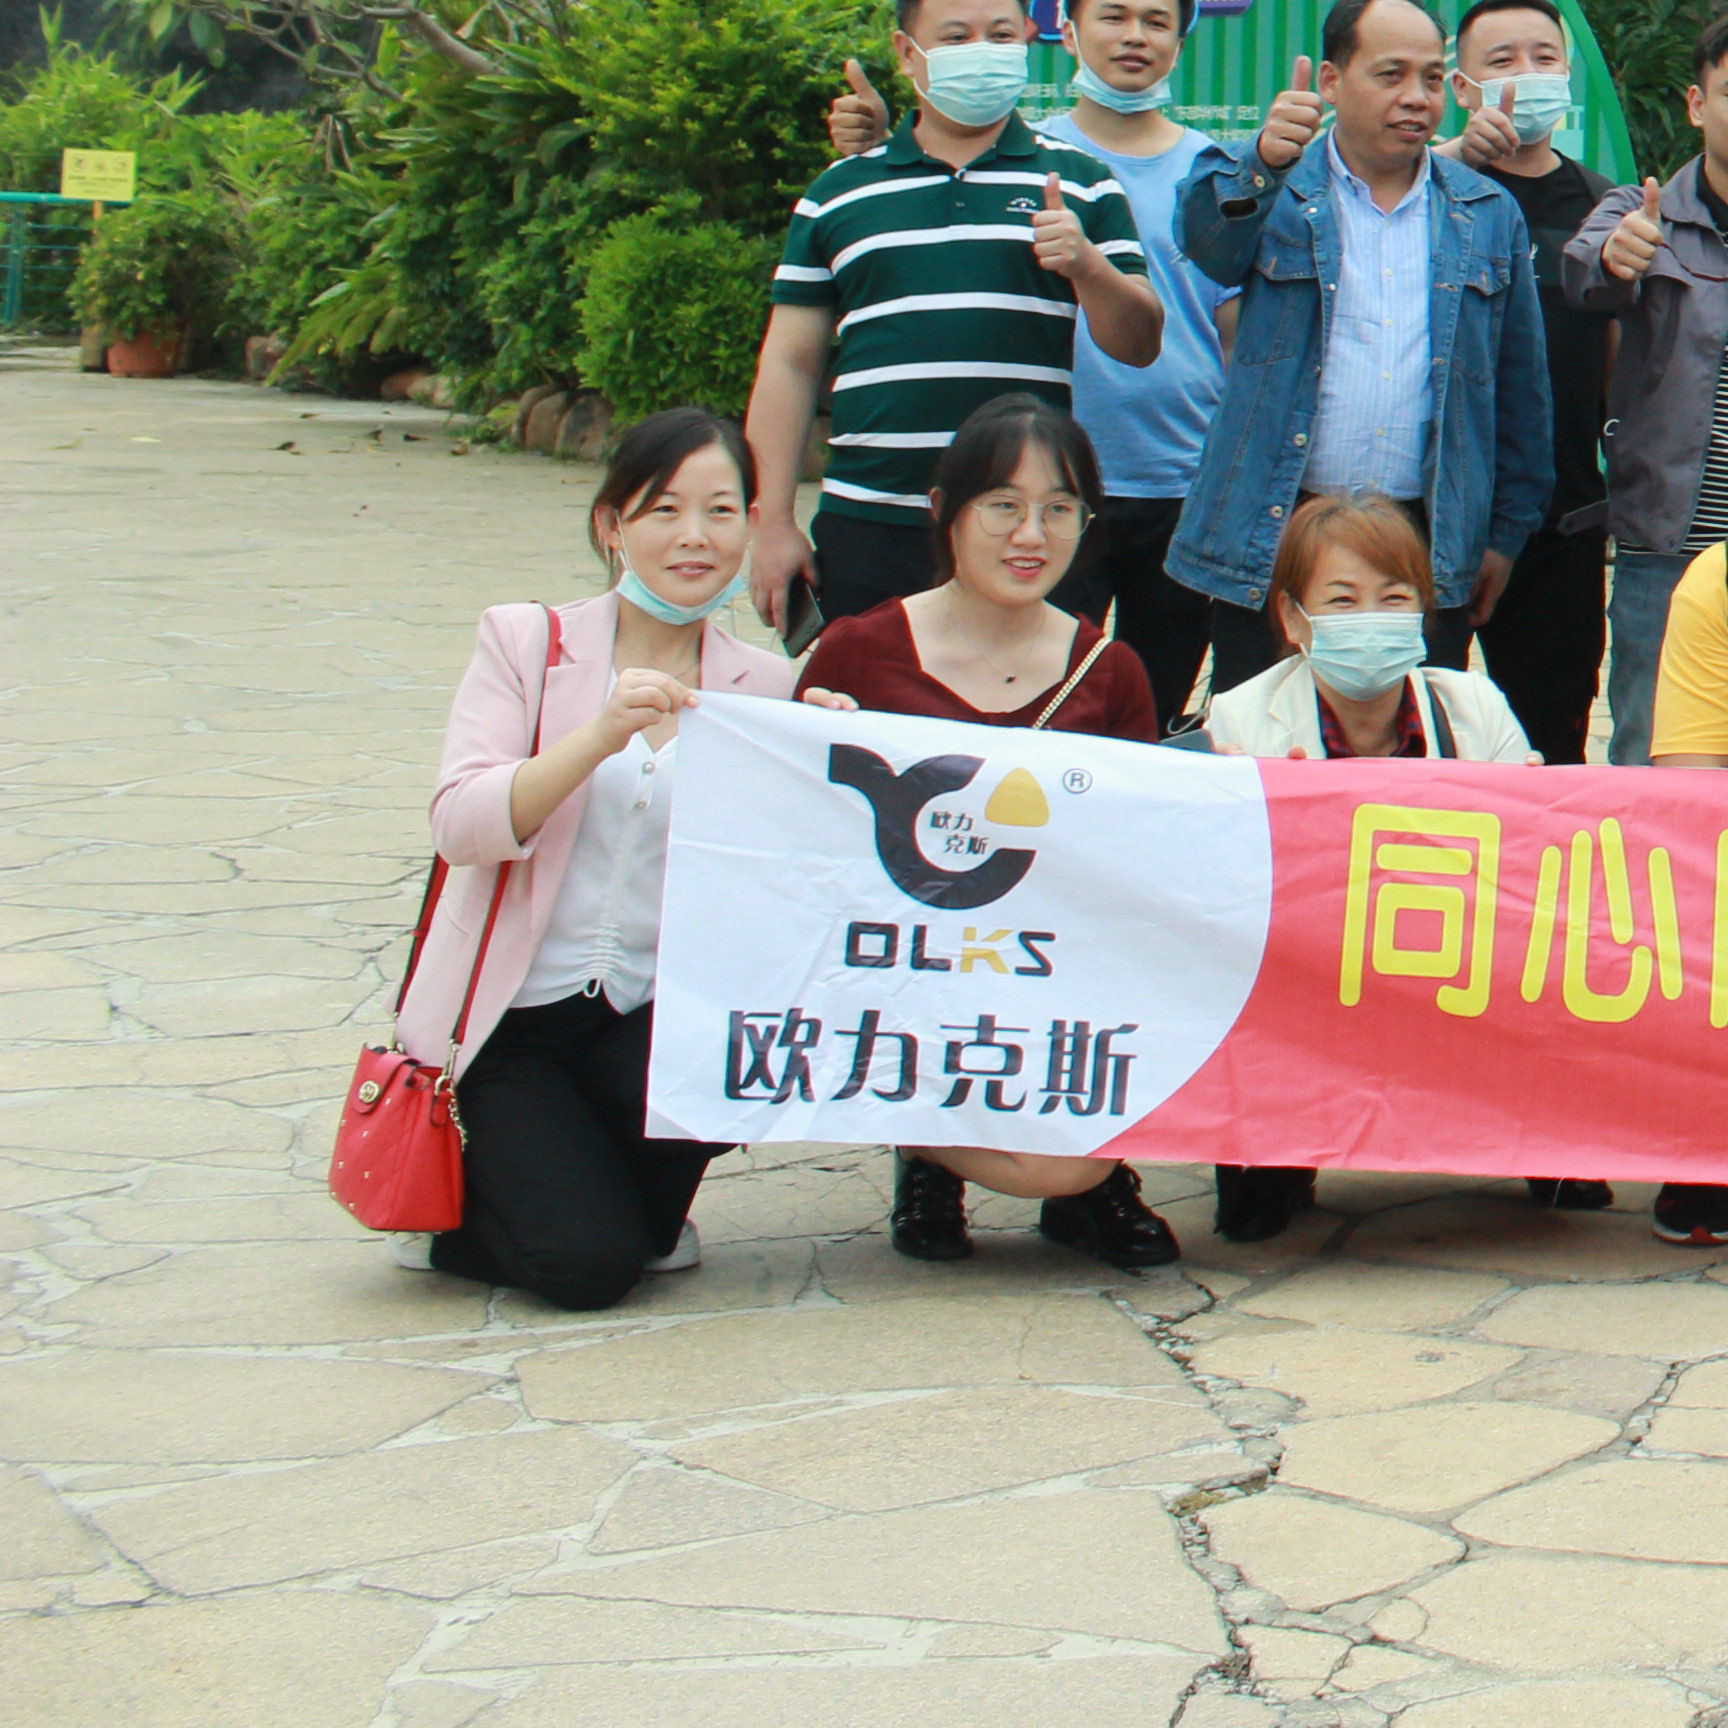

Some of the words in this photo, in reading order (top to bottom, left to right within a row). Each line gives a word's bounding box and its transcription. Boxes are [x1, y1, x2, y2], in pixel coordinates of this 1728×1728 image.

[929, 810, 974, 833] 欧力
[843, 920, 1057, 978] OLKS
[723, 1005, 1141, 1118] 欧力克斯
